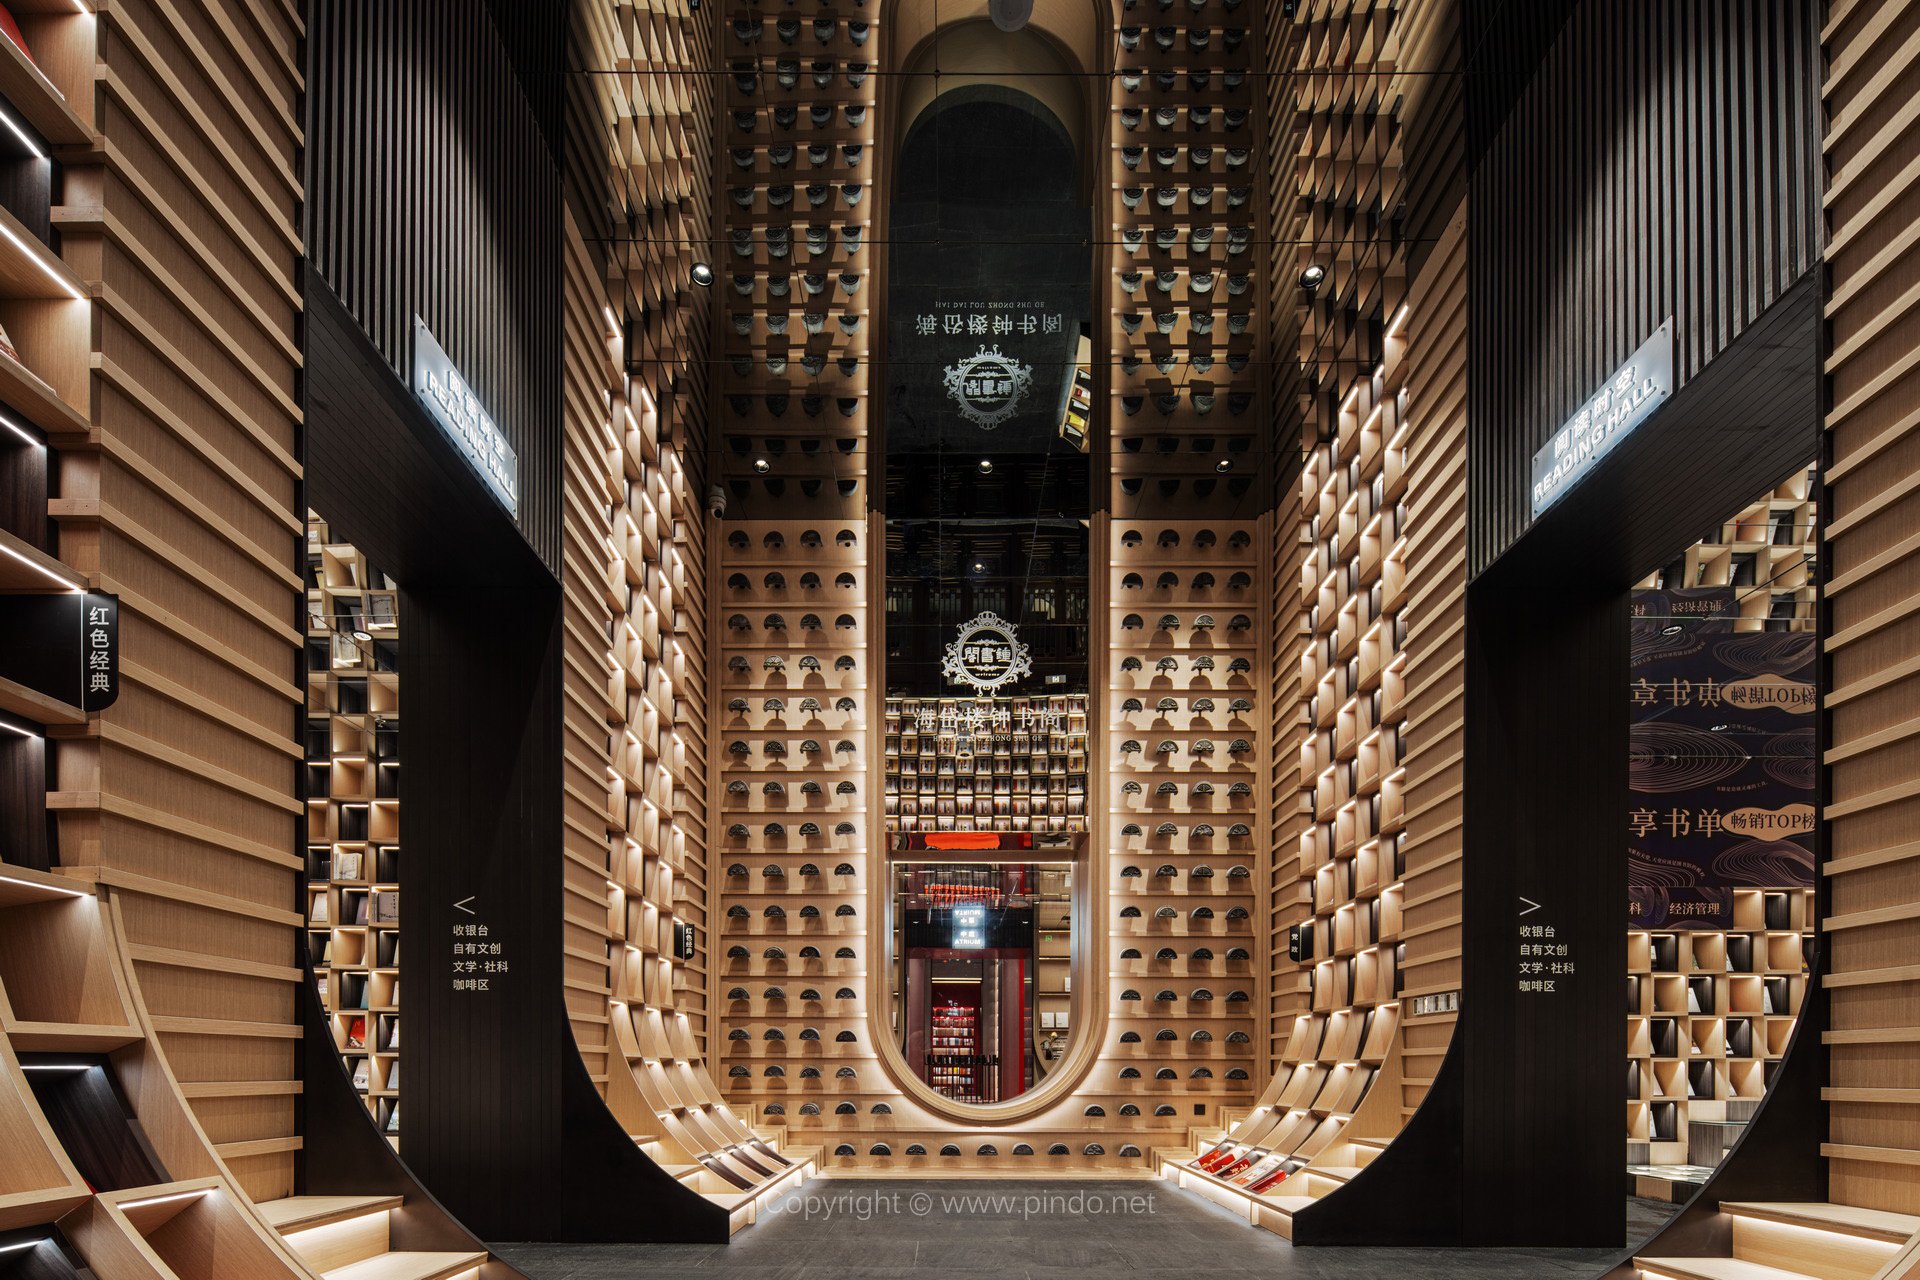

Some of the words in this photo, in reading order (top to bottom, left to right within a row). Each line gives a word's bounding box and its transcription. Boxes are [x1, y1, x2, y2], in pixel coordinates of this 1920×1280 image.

[427, 371, 484, 461] READING
[488, 453, 515, 501] HALL
[1534, 422, 1606, 502] READING
[1607, 377, 1657, 433] HALL
[89, 606, 110, 692] 红色经典
[913, 706, 1061, 729] 海岱楼钟书阁
[1628, 807, 1723, 838] 享书单
[1669, 902, 1720, 915] 经济管理
[453, 924, 489, 937] 收银台
[1519, 925, 1556, 938] 收银台
[453, 942, 501, 955] 自有文创
[1520, 943, 1568, 956] 自有文创
[453, 960, 509, 973] 文学·社科
[1519, 961, 1575, 974] 文学·社科
[453, 979, 489, 991] 咖啡区
[1519, 980, 1555, 992] 咖啡区
